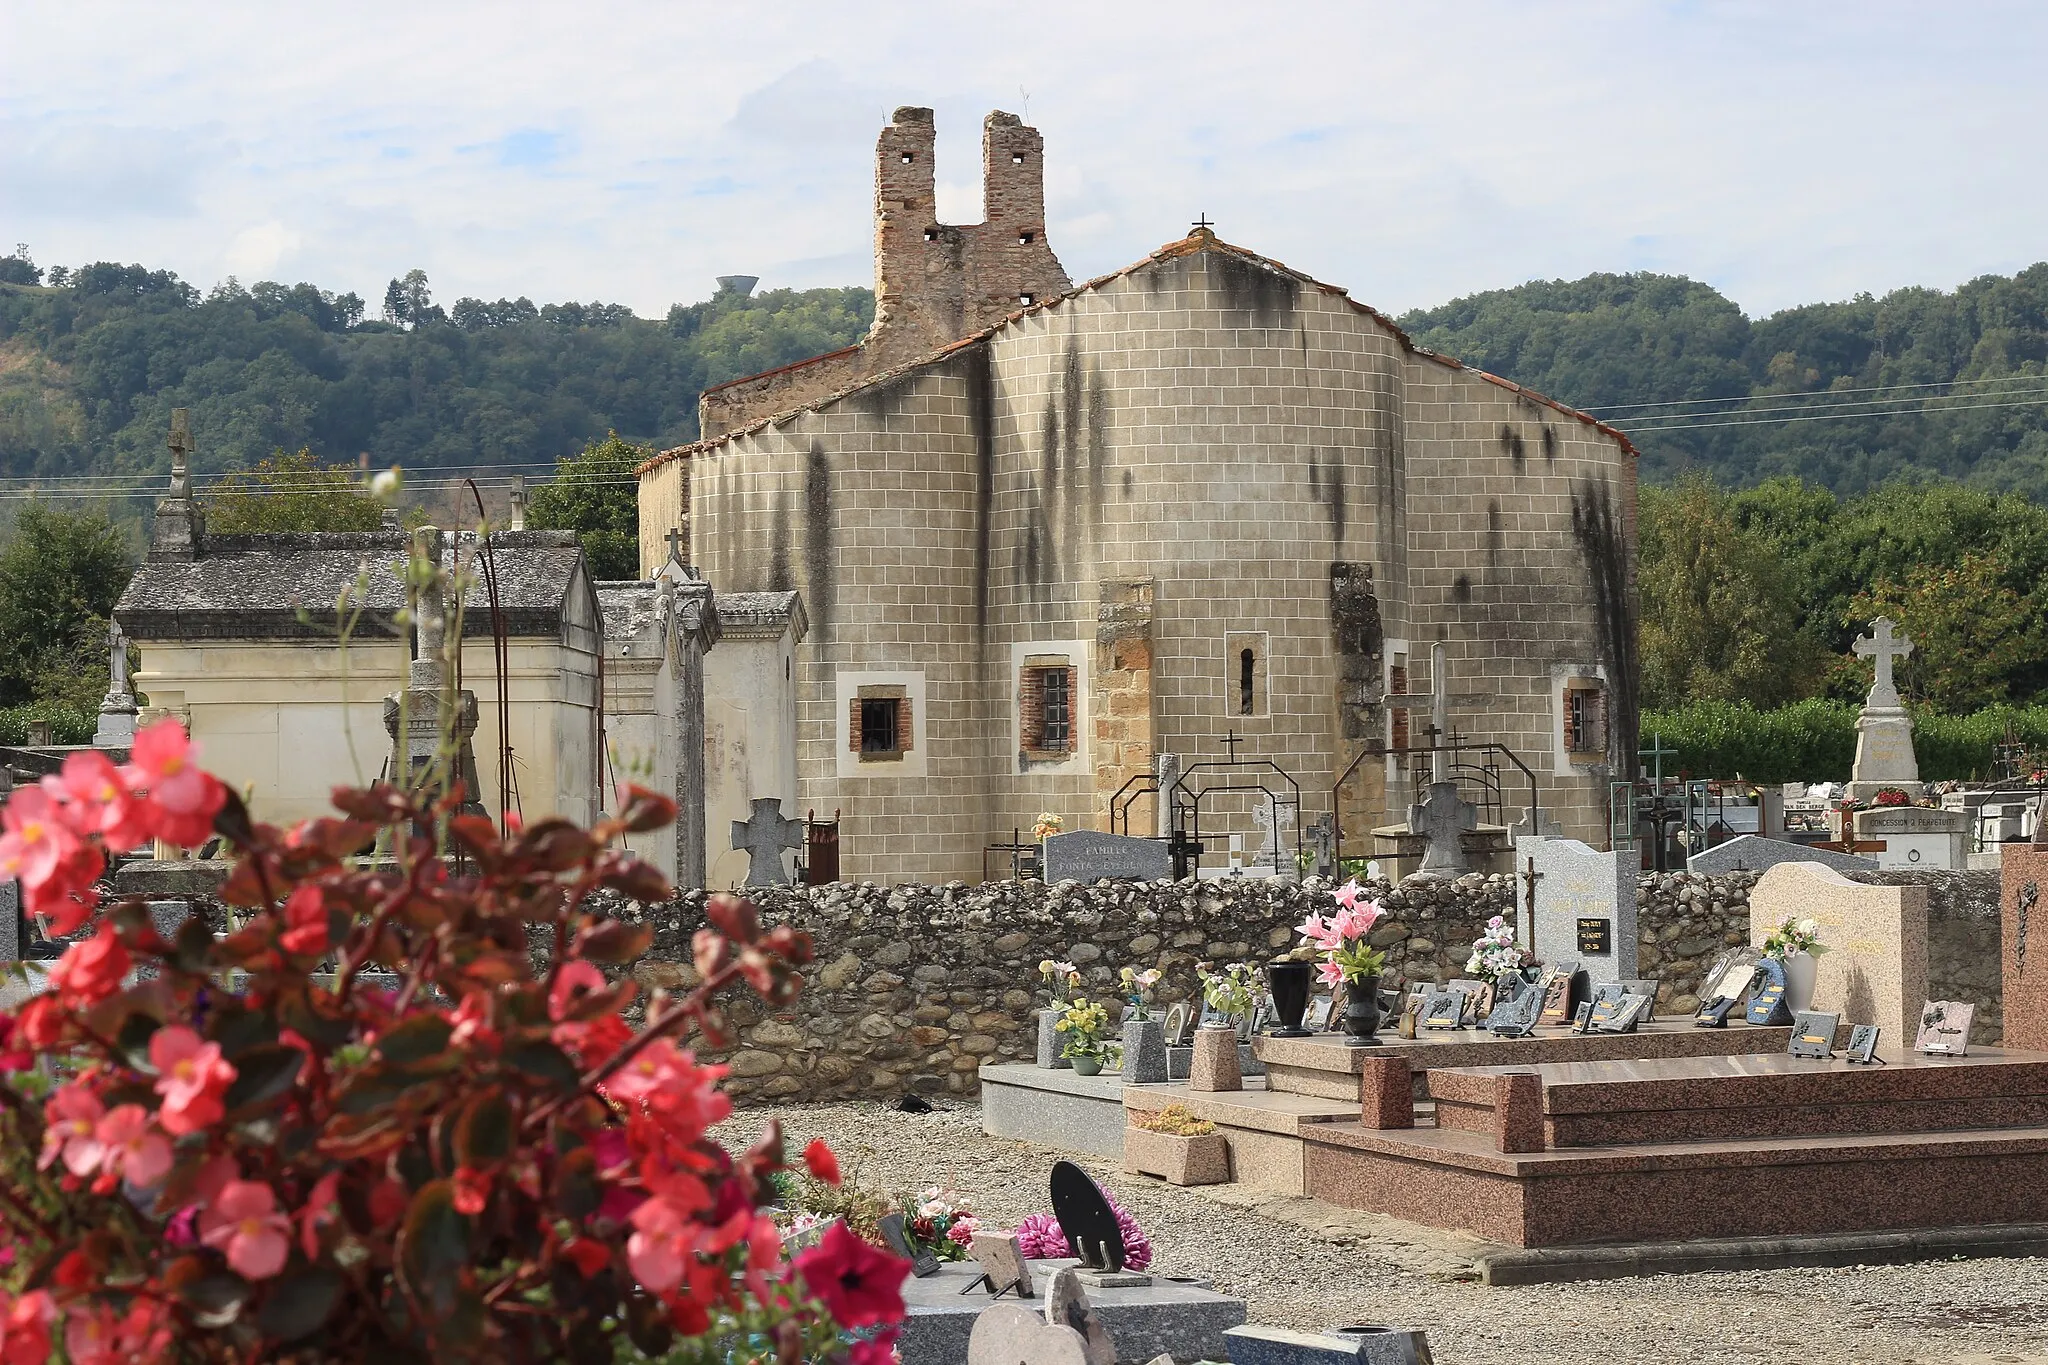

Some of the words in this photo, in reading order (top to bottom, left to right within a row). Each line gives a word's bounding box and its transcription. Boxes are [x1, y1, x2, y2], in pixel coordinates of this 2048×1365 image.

[1870, 818, 1908, 827] CONCESSION
[1086, 845, 1128, 855] FAMILLE
[1059, 862, 1093, 871] FONTA
